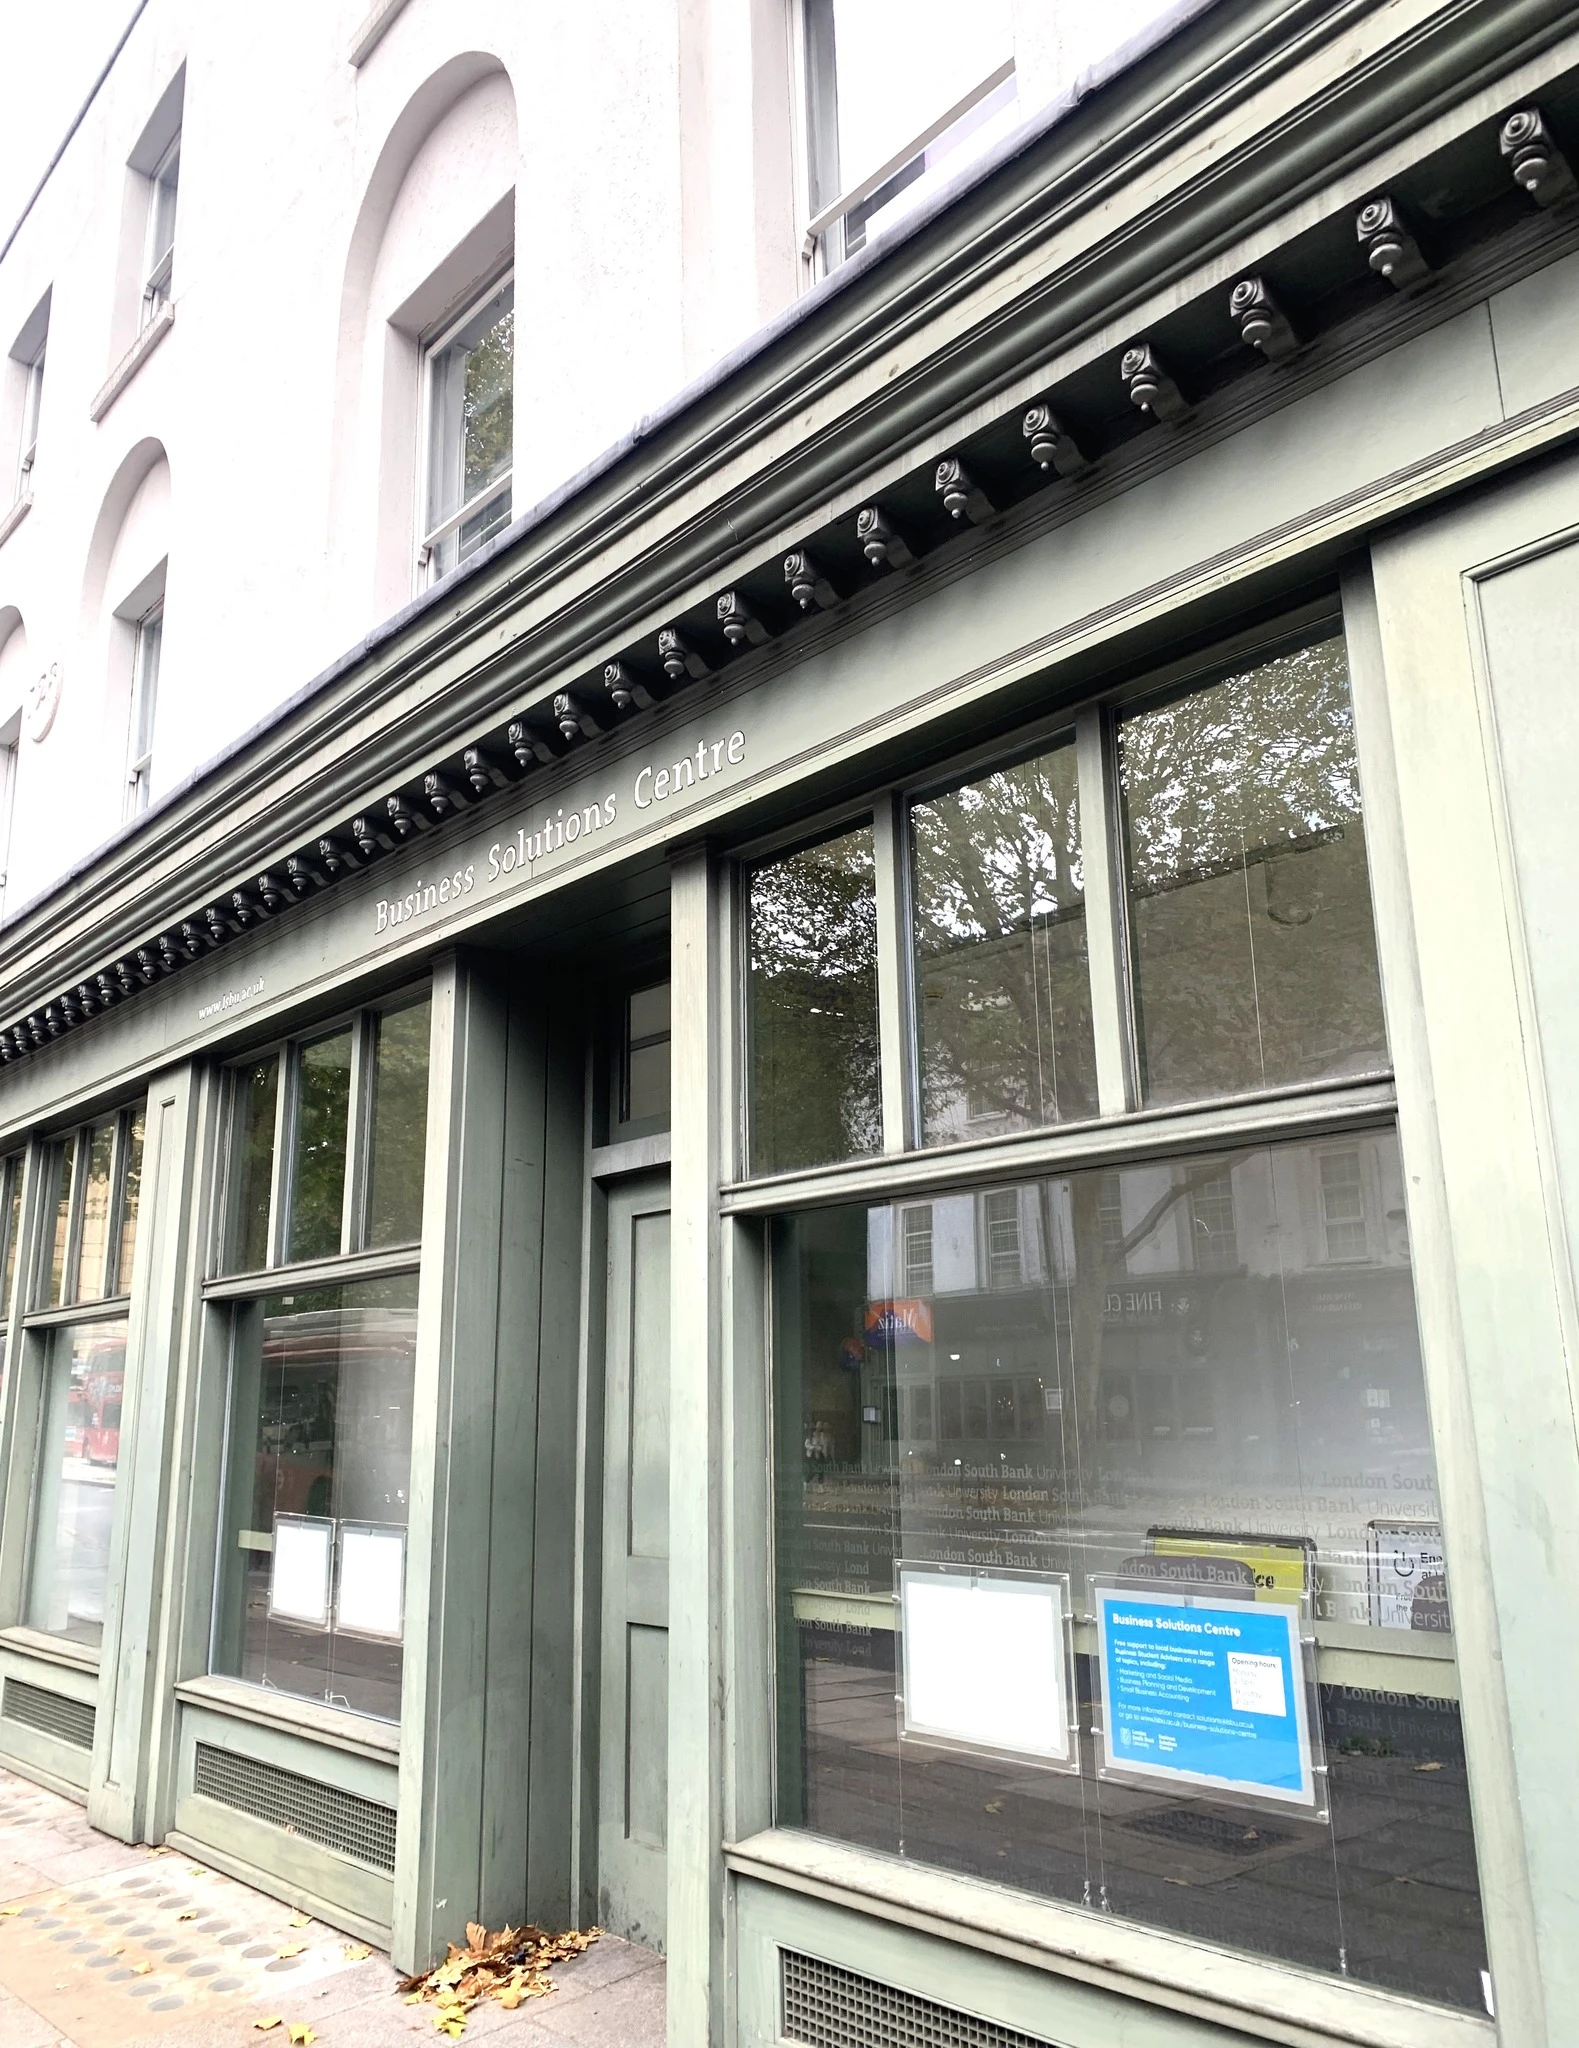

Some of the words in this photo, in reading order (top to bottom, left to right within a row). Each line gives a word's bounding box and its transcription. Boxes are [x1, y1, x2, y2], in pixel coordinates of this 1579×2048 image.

[374, 864, 475, 936] Business
[488, 791, 617, 882] Solutions
[634, 730, 746, 809] Centre
[198, 976, 265, 1020] www.lsbu.ac.uk
[926, 1462, 962, 1478] ondon
[964, 1464, 999, 1479] South
[1001, 1464, 1034, 1480] Bank
[1321, 1470, 1388, 1489] London
[1003, 1486, 1049, 1501] London
[1316, 1496, 1362, 1514] Bank
[926, 1503, 965, 1519] ondon
[967, 1506, 1001, 1522] South
[1003, 1507, 1036, 1524] Bank
[1247, 1518, 1320, 1541] University
[843, 1541, 870, 1556] Bank
[967, 1548, 1003, 1566] South
[1005, 1552, 1038, 1568] Bank
[813, 1578, 843, 1592] South
[844, 1580, 872, 1594] Bank
[1159, 1561, 1203, 1580] South
[1206, 1564, 1248, 1585] Bank
[844, 1560, 870, 1576] Lond
[814, 1617, 844, 1633] South
[845, 1621, 872, 1637] Bank
[1112, 1612, 1154, 1628] Business
[1155, 1617, 1203, 1634] Solutions
[1204, 1622, 1241, 1637] Centre
[1114, 1639, 1126, 1647] Free
[1127, 1641, 1148, 1650] support
[1155, 1644, 1169, 1652] local
[1199, 1649, 1214, 1657] from
[1114, 1648, 1137, 1657] Business
[1138, 1650, 1159, 1659] Student
[1198, 1659, 1216, 1668] range
[1231, 1657, 1258, 1668] Opening
[1119, 1667, 1145, 1679] Marketing
[1145, 1671, 1157, 1679] and
[1157, 1672, 1174, 1681] Social
[1174, 1675, 1193, 1684] Media
[1119, 1677, 1142, 1686] Business
[1142, 1679, 1166, 1690] Planning
[1166, 1683, 1178, 1691] and
[1178, 1684, 1217, 1697] Development
[1120, 1685, 1135, 1693] Small
[1135, 1687, 1158, 1697] Business
[1158, 1690, 1189, 1702] Accounting
[1341, 1682, 1411, 1708] London
[1414, 1691, 1459, 1714] Sout
[1141, 1706, 1173, 1717] information
[1173, 1711, 1195, 1720] contact
